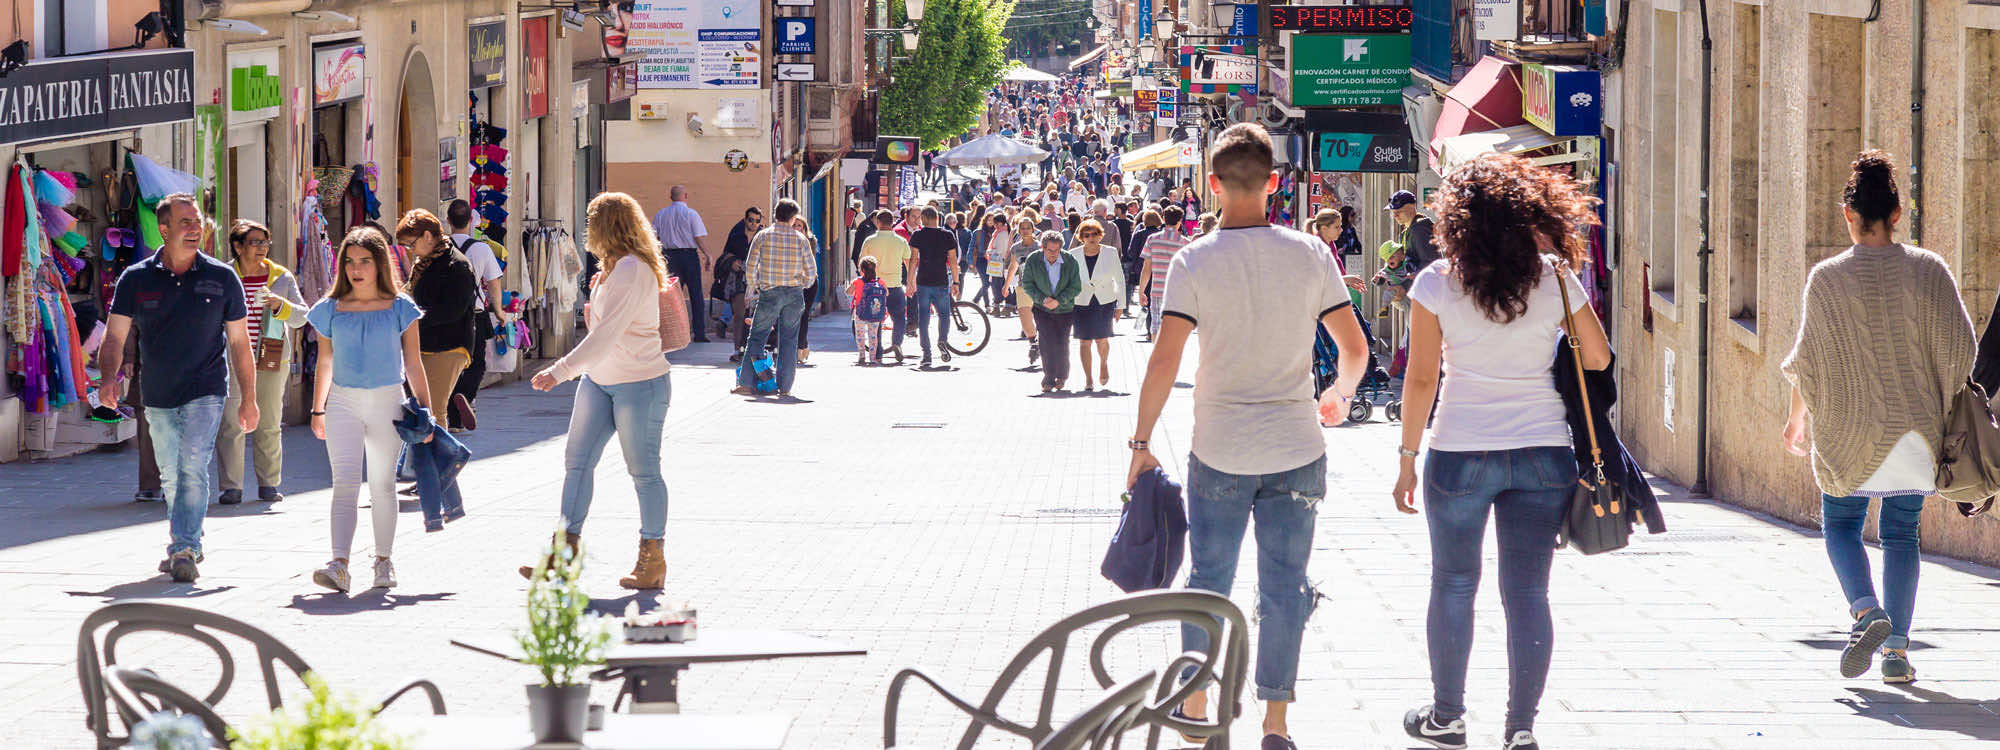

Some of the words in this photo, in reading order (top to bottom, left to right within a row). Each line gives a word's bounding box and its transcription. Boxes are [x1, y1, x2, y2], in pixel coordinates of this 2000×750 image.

[1297, 8, 1413, 27] PERMISO
[786, 21, 807, 41] P
[1194, 71, 1253, 80] CLORS
[1294, 68, 1341, 76] RENOVACIÓN
[653, 74, 691, 82] PERMANENTE
[0, 78, 104, 126] ZAPATERIA
[109, 67, 192, 111] FANTASIA
[1374, 146, 1402, 155] Outlet
[1374, 154, 1403, 163] SHOP
